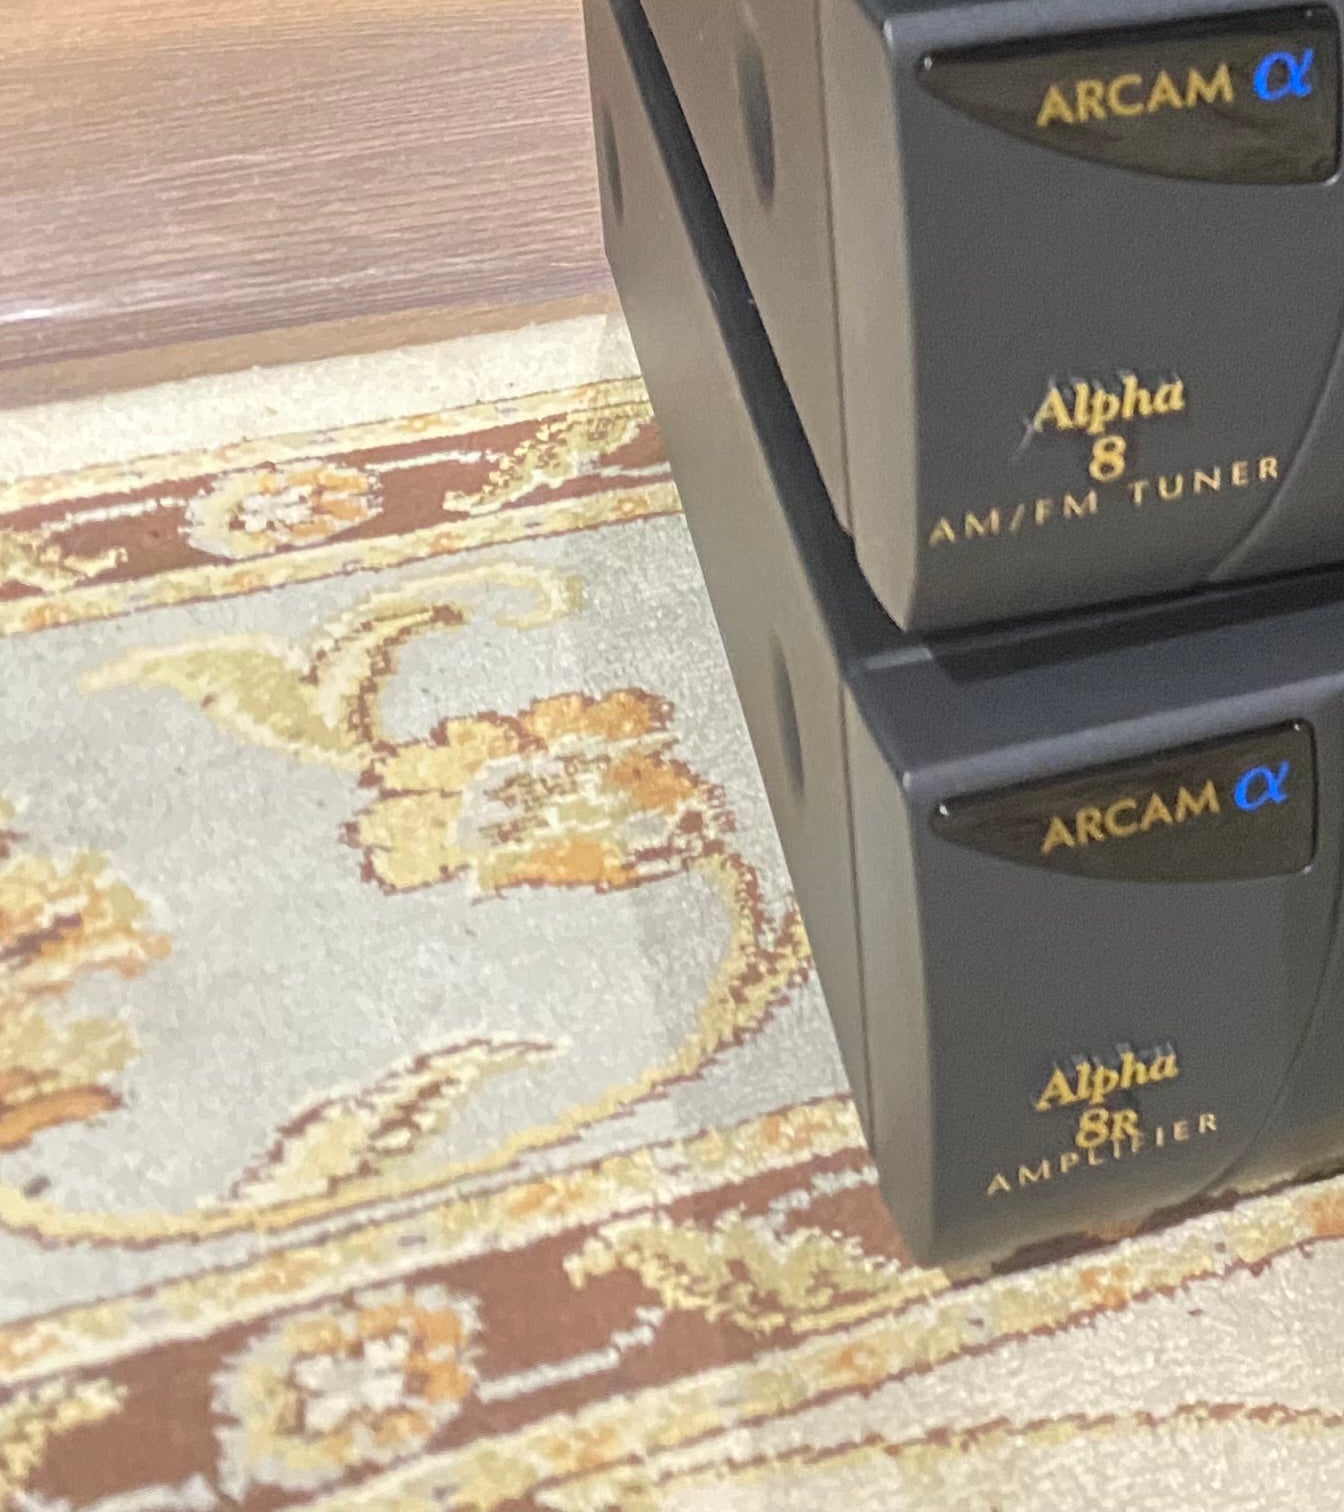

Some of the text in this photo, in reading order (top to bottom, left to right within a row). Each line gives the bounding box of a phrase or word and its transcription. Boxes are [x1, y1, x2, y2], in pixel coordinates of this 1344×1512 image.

[1037, 63, 1234, 128] ARCAM
[1030, 372, 1185, 435] Alpha
[1088, 435, 1127, 483] 8
[928, 456, 1279, 548] AM/FM TUNER
[1040, 779, 1221, 855] ARCAM
[1034, 1048, 1180, 1113] Alpha
[1074, 1107, 1140, 1149] 8R
